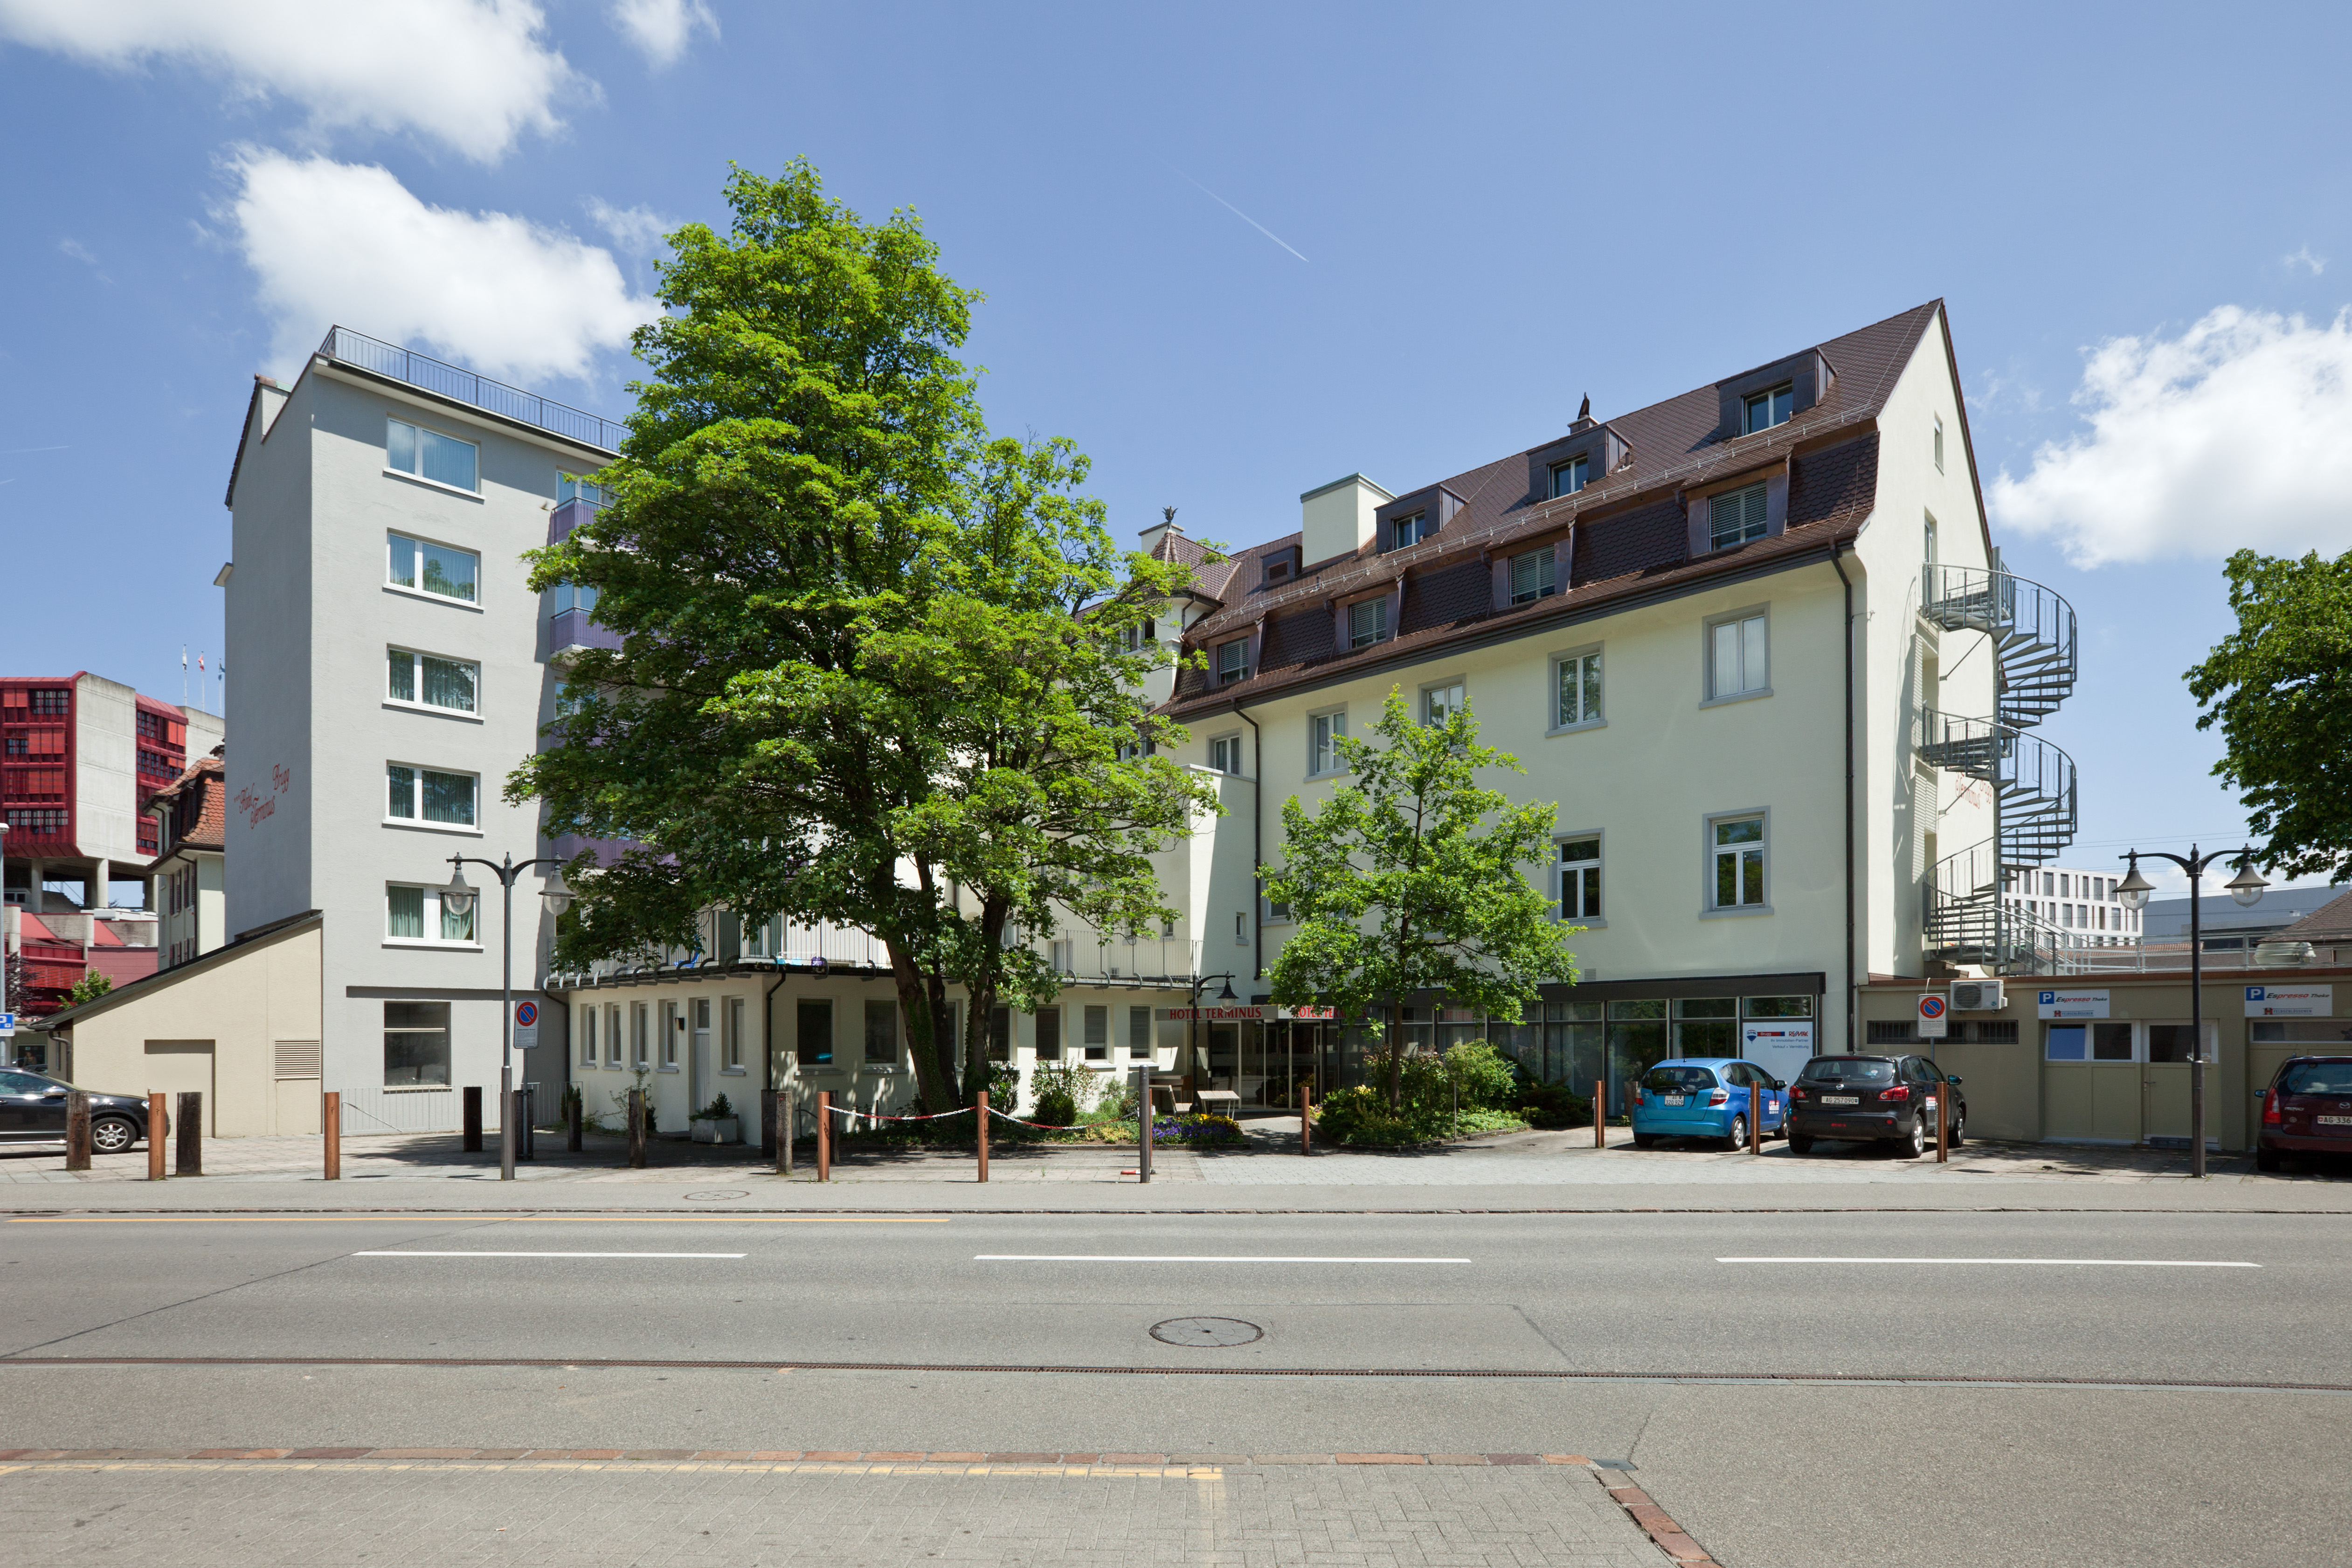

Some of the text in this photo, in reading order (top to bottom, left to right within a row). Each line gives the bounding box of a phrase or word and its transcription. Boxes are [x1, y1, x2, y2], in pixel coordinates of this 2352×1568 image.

[272, 763, 290, 794] Brugg
[239, 782, 255, 814] Hotel
[250, 795, 275, 829] Terminus
[2043, 993, 2052, 1002] P
[2250, 989, 2261, 999] P
[1205, 1007, 1262, 1019] TERMINUS
